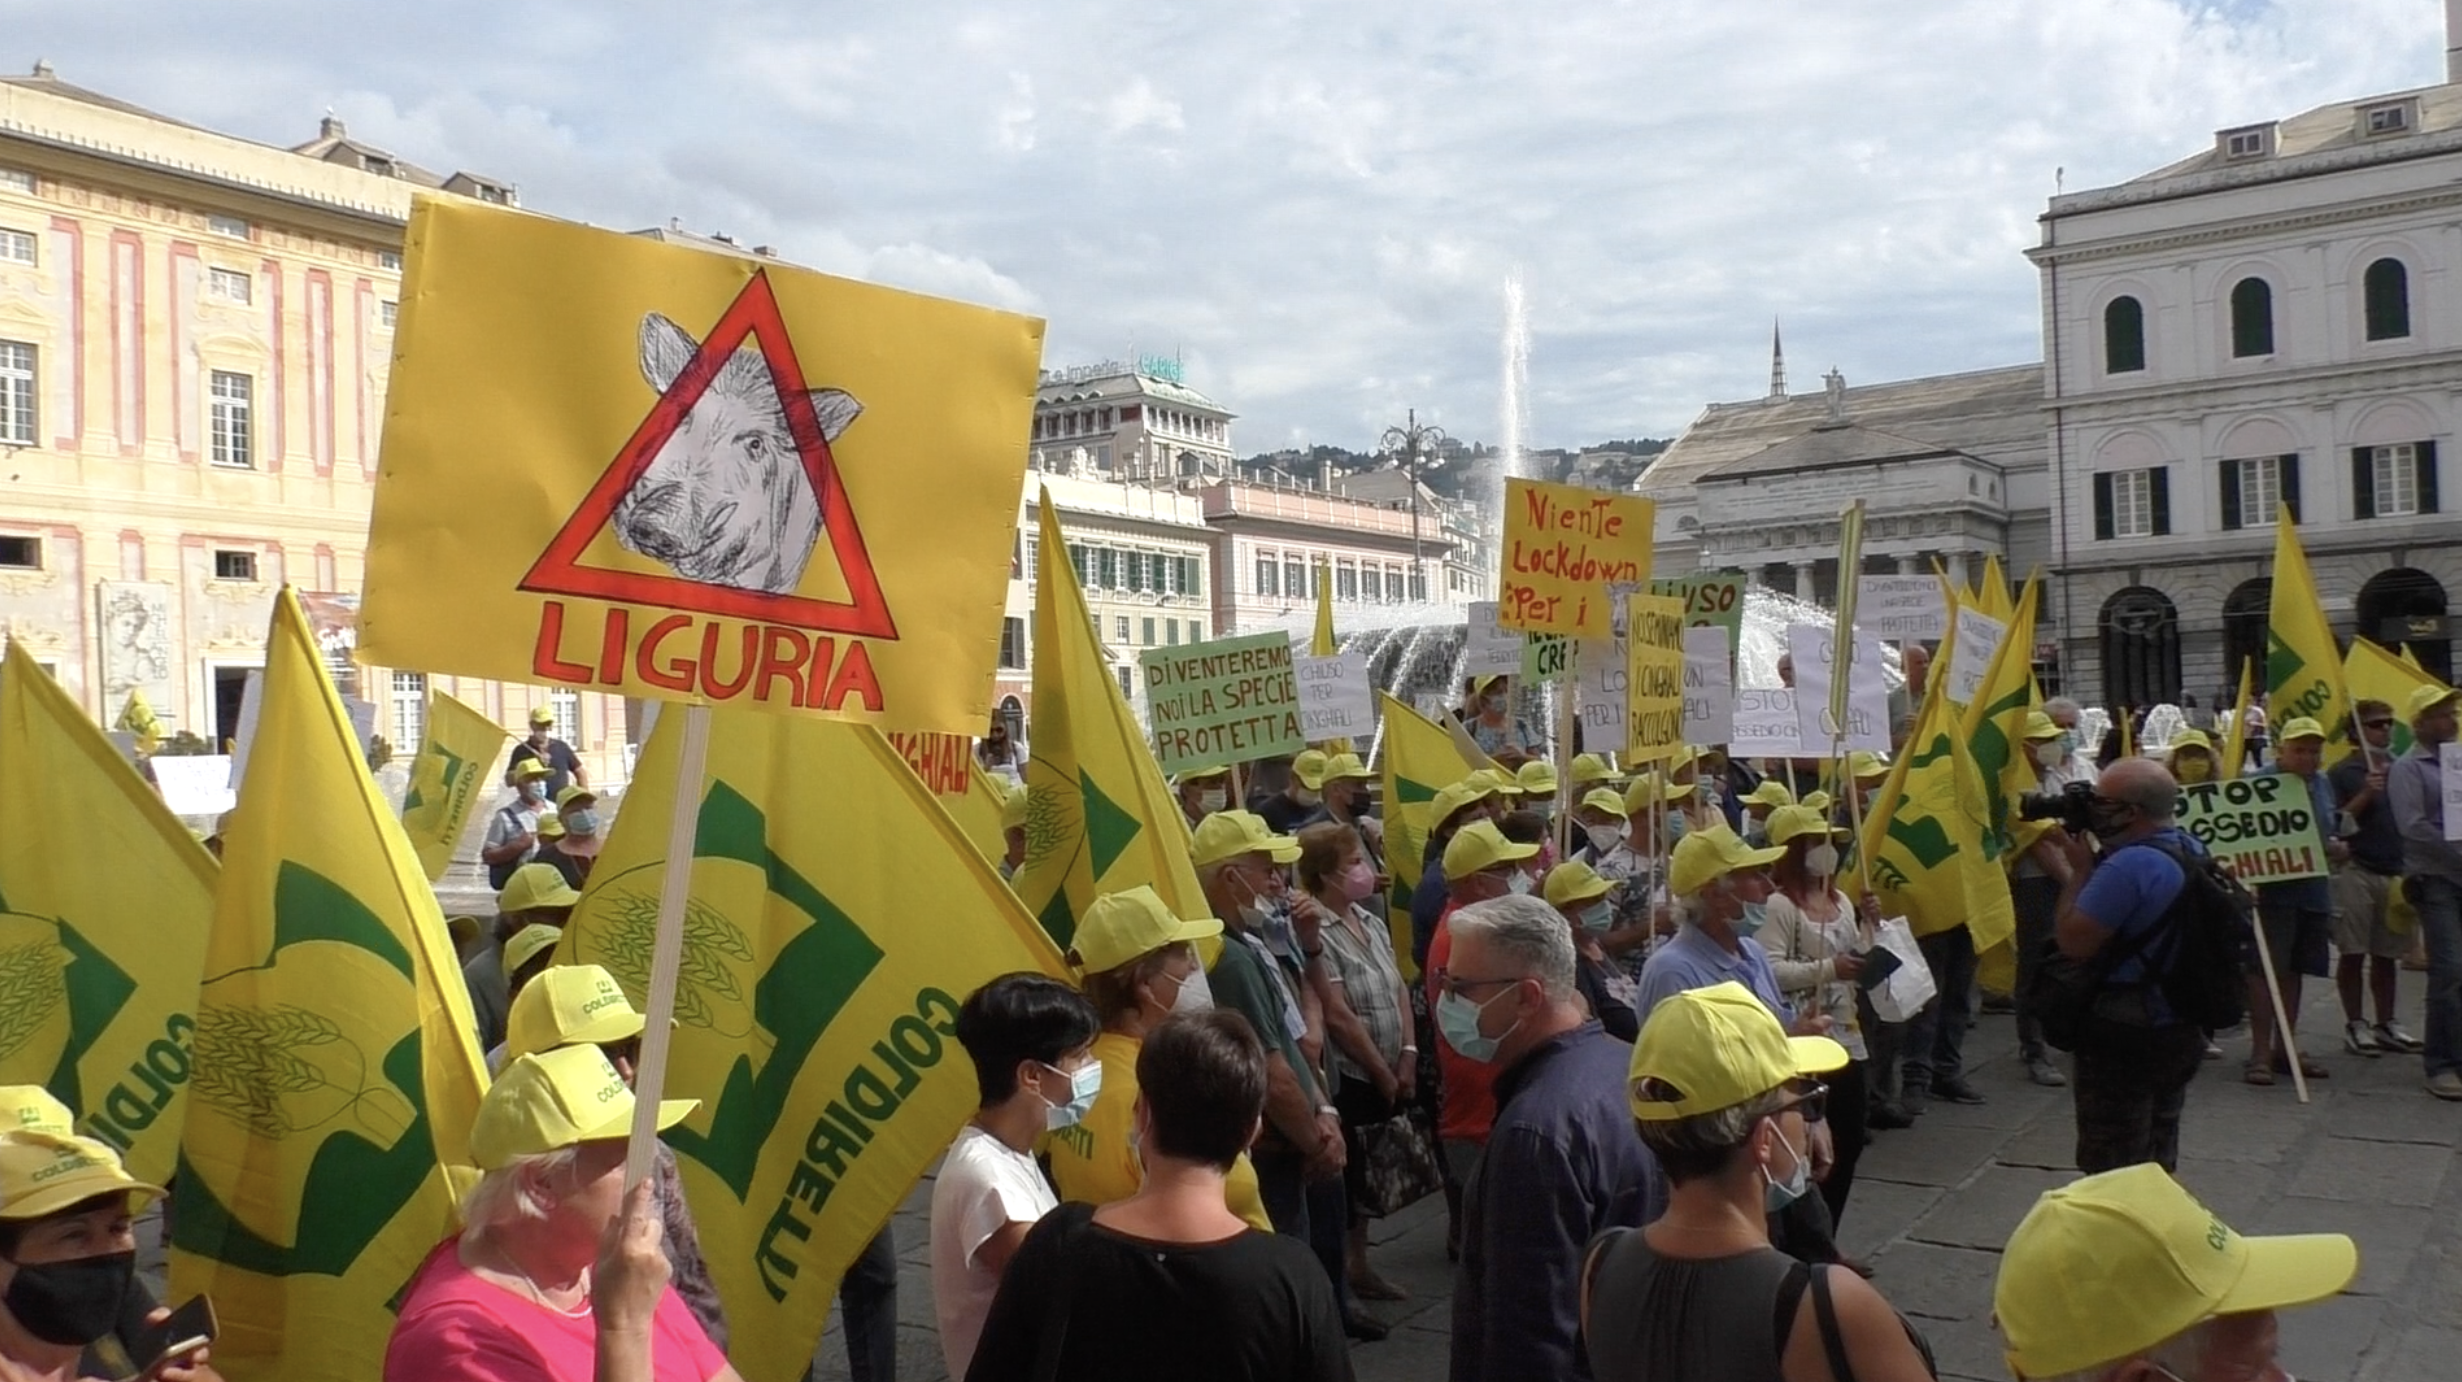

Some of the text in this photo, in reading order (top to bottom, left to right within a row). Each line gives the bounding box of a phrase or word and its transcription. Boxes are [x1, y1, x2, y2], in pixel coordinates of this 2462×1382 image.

[532, 600, 884, 712] LIGURIA
[1301, 662, 1345, 681] CHIUSO
[1310, 683, 1333, 701] PER
[1741, 689, 1796, 711] STO
[1157, 711, 1302, 761] PROTETTA
[2178, 809, 2310, 844] SSEDIO
